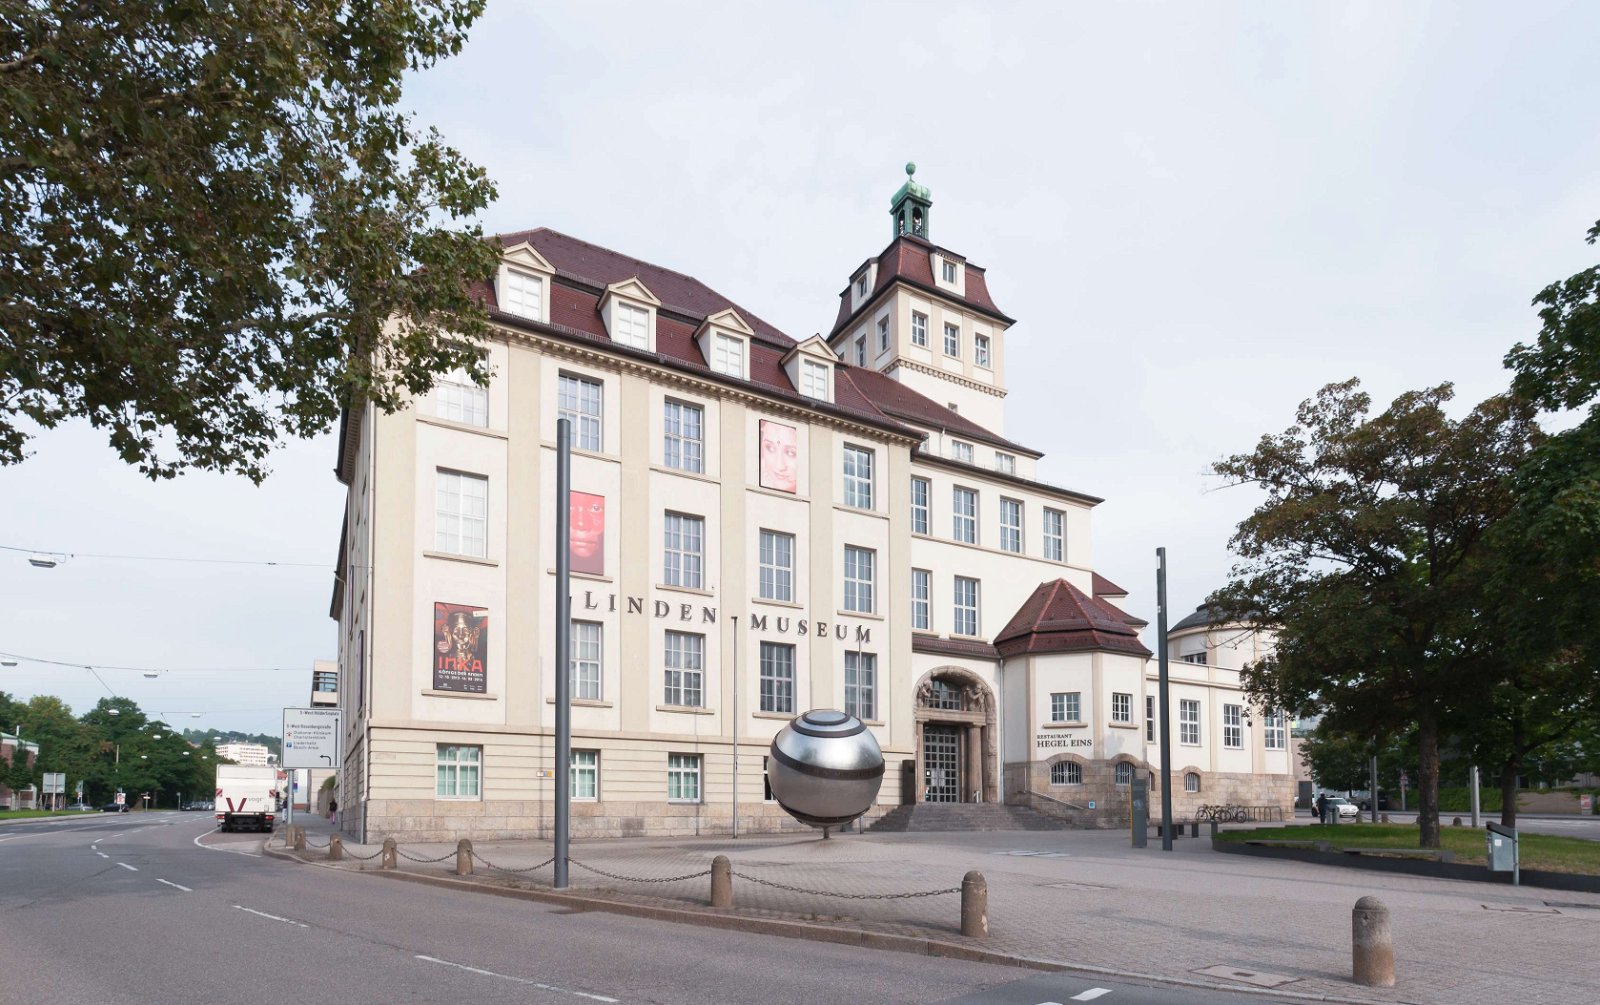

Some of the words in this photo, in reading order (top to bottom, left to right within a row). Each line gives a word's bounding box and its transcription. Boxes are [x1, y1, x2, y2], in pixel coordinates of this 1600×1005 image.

[584, 591, 717, 624] LINDEN
[751, 613, 871, 643] MUSEUM
[1071, 739, 1092, 747] EINS
